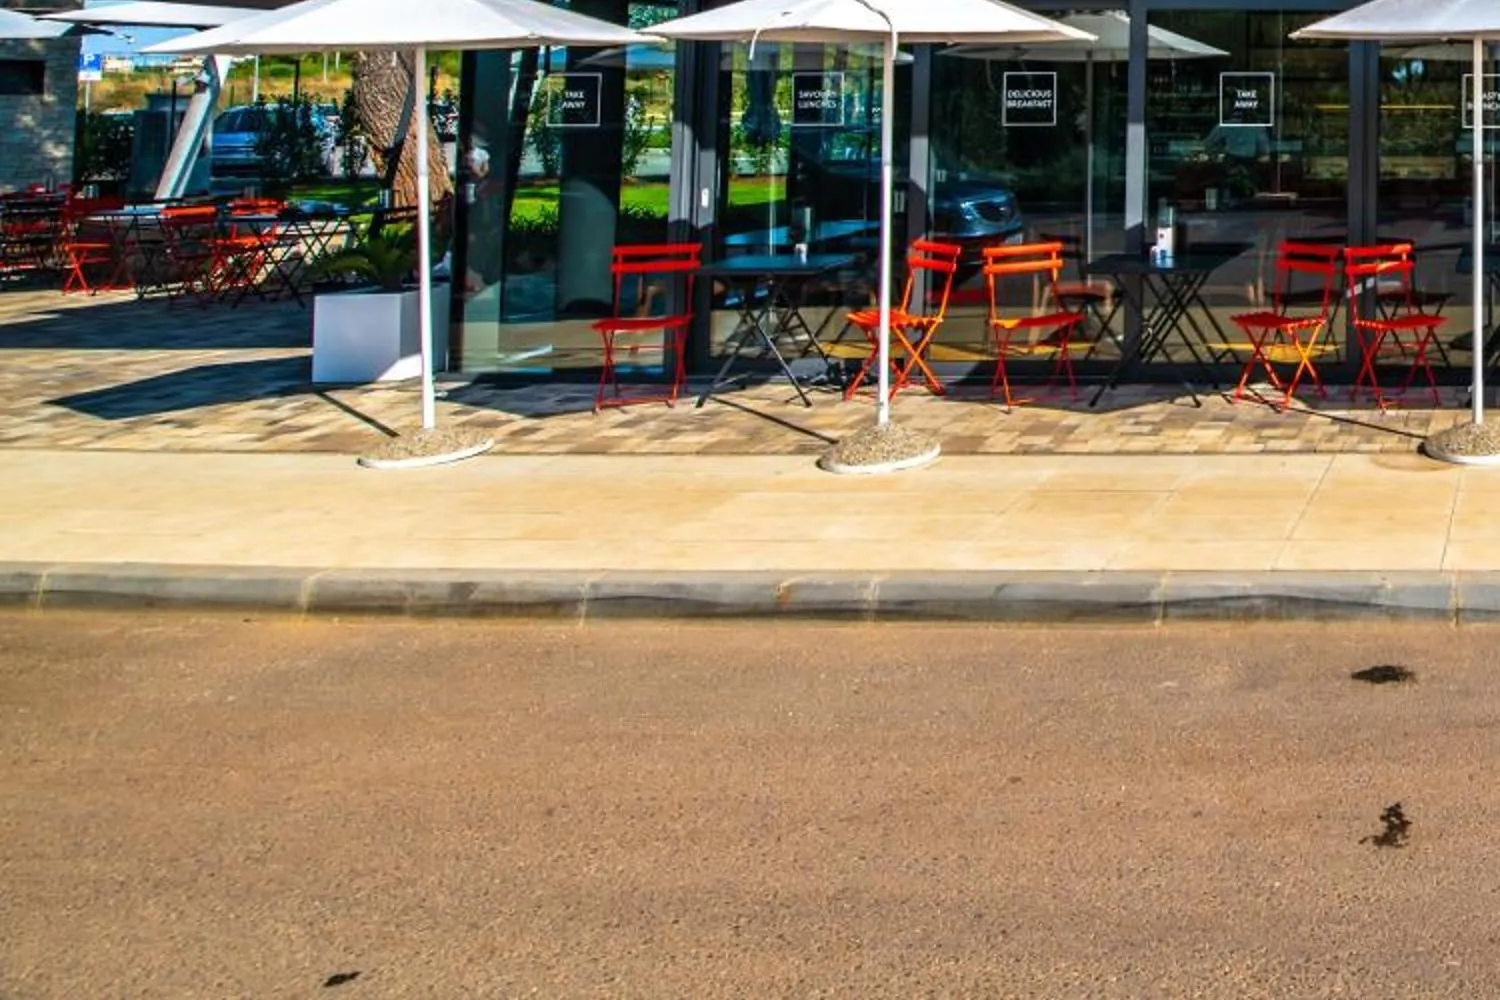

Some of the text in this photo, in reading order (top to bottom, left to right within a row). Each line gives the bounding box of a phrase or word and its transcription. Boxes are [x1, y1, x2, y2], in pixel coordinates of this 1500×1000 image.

[564, 91, 585, 99] TAKE
[1007, 89, 1052, 99] DELICIOUS
[1236, 89, 1257, 99] TAKE
[561, 101, 585, 109] AWAY
[1007, 99, 1052, 109] BREAKFAST
[1234, 100, 1258, 109] AWAY
